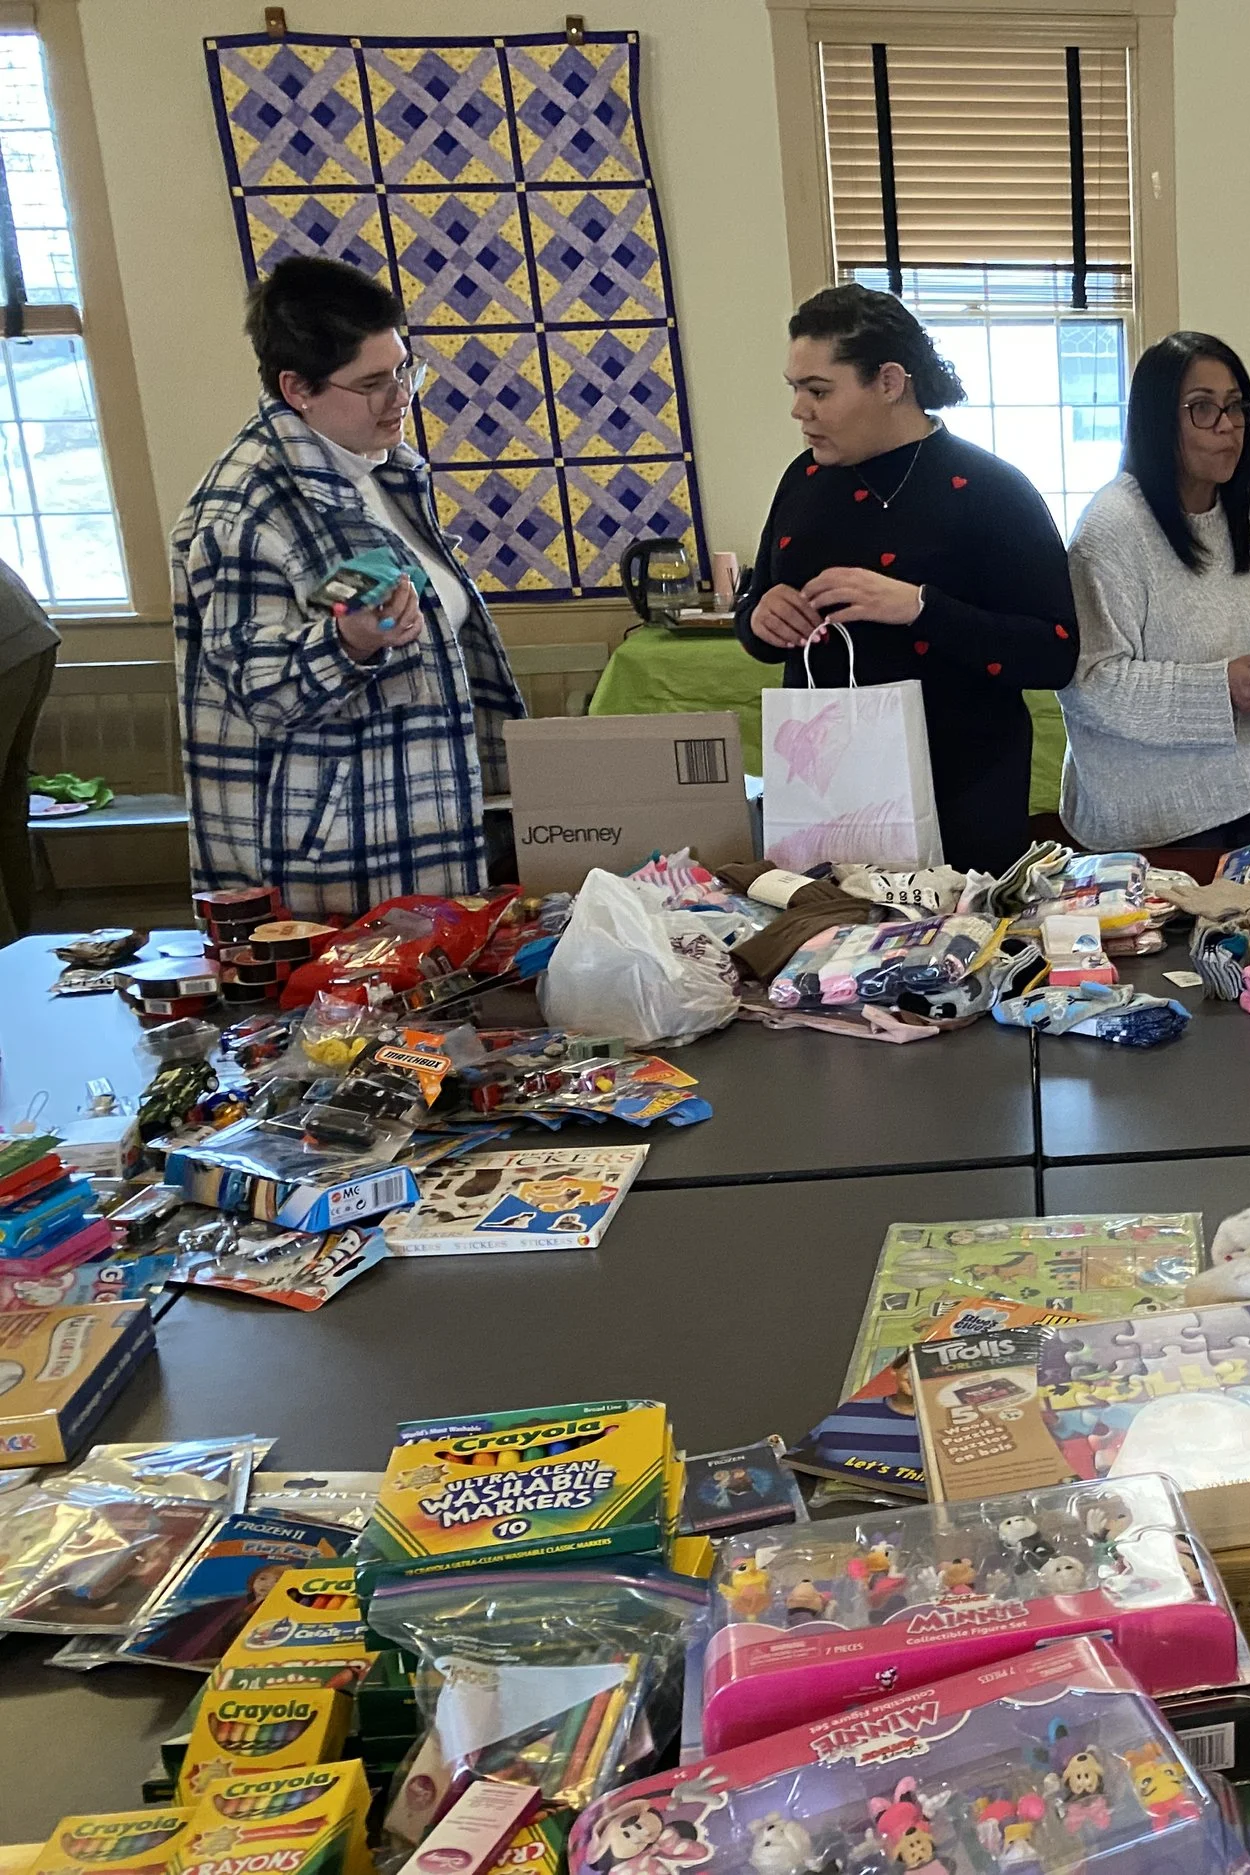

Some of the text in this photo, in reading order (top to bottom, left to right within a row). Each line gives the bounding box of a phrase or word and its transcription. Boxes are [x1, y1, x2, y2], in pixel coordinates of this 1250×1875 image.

[521, 825, 622, 845] JCPenney
[383, 1051, 443, 1069] MATCHBOX
[921, 1338, 1016, 1366] Trolls
[933, 1361, 984, 1374] WORLD
[951, 1406, 979, 1425] 5
[452, 1420, 602, 1451] Crayola
[942, 1427, 1003, 1445] Puzzles
[944, 1420, 991, 1436] Wood
[949, 1435, 1009, 1455] Puzzles
[446, 1459, 598, 1492] ULTRA-CLEAN
[845, 1456, 891, 1474] Let's
[421, 1469, 616, 1515] WASHABLE
[441, 1489, 592, 1528] MARKERS
[234, 1521, 305, 1540] FROZEN II
[497, 1520, 528, 1537] 10
[906, 1600, 1029, 1634] MINNIE
[906, 1620, 1028, 1645] Collectible Figure Set
[825, 1642, 864, 1656] 7 PIECES
[217, 1700, 312, 1721] Crayola
[809, 1689, 935, 1734] Collectible Figure Set
[810, 1701, 940, 1760] MINNIE
[224, 1771, 331, 1798] Crayola
[74, 1816, 180, 1837] Crayola
